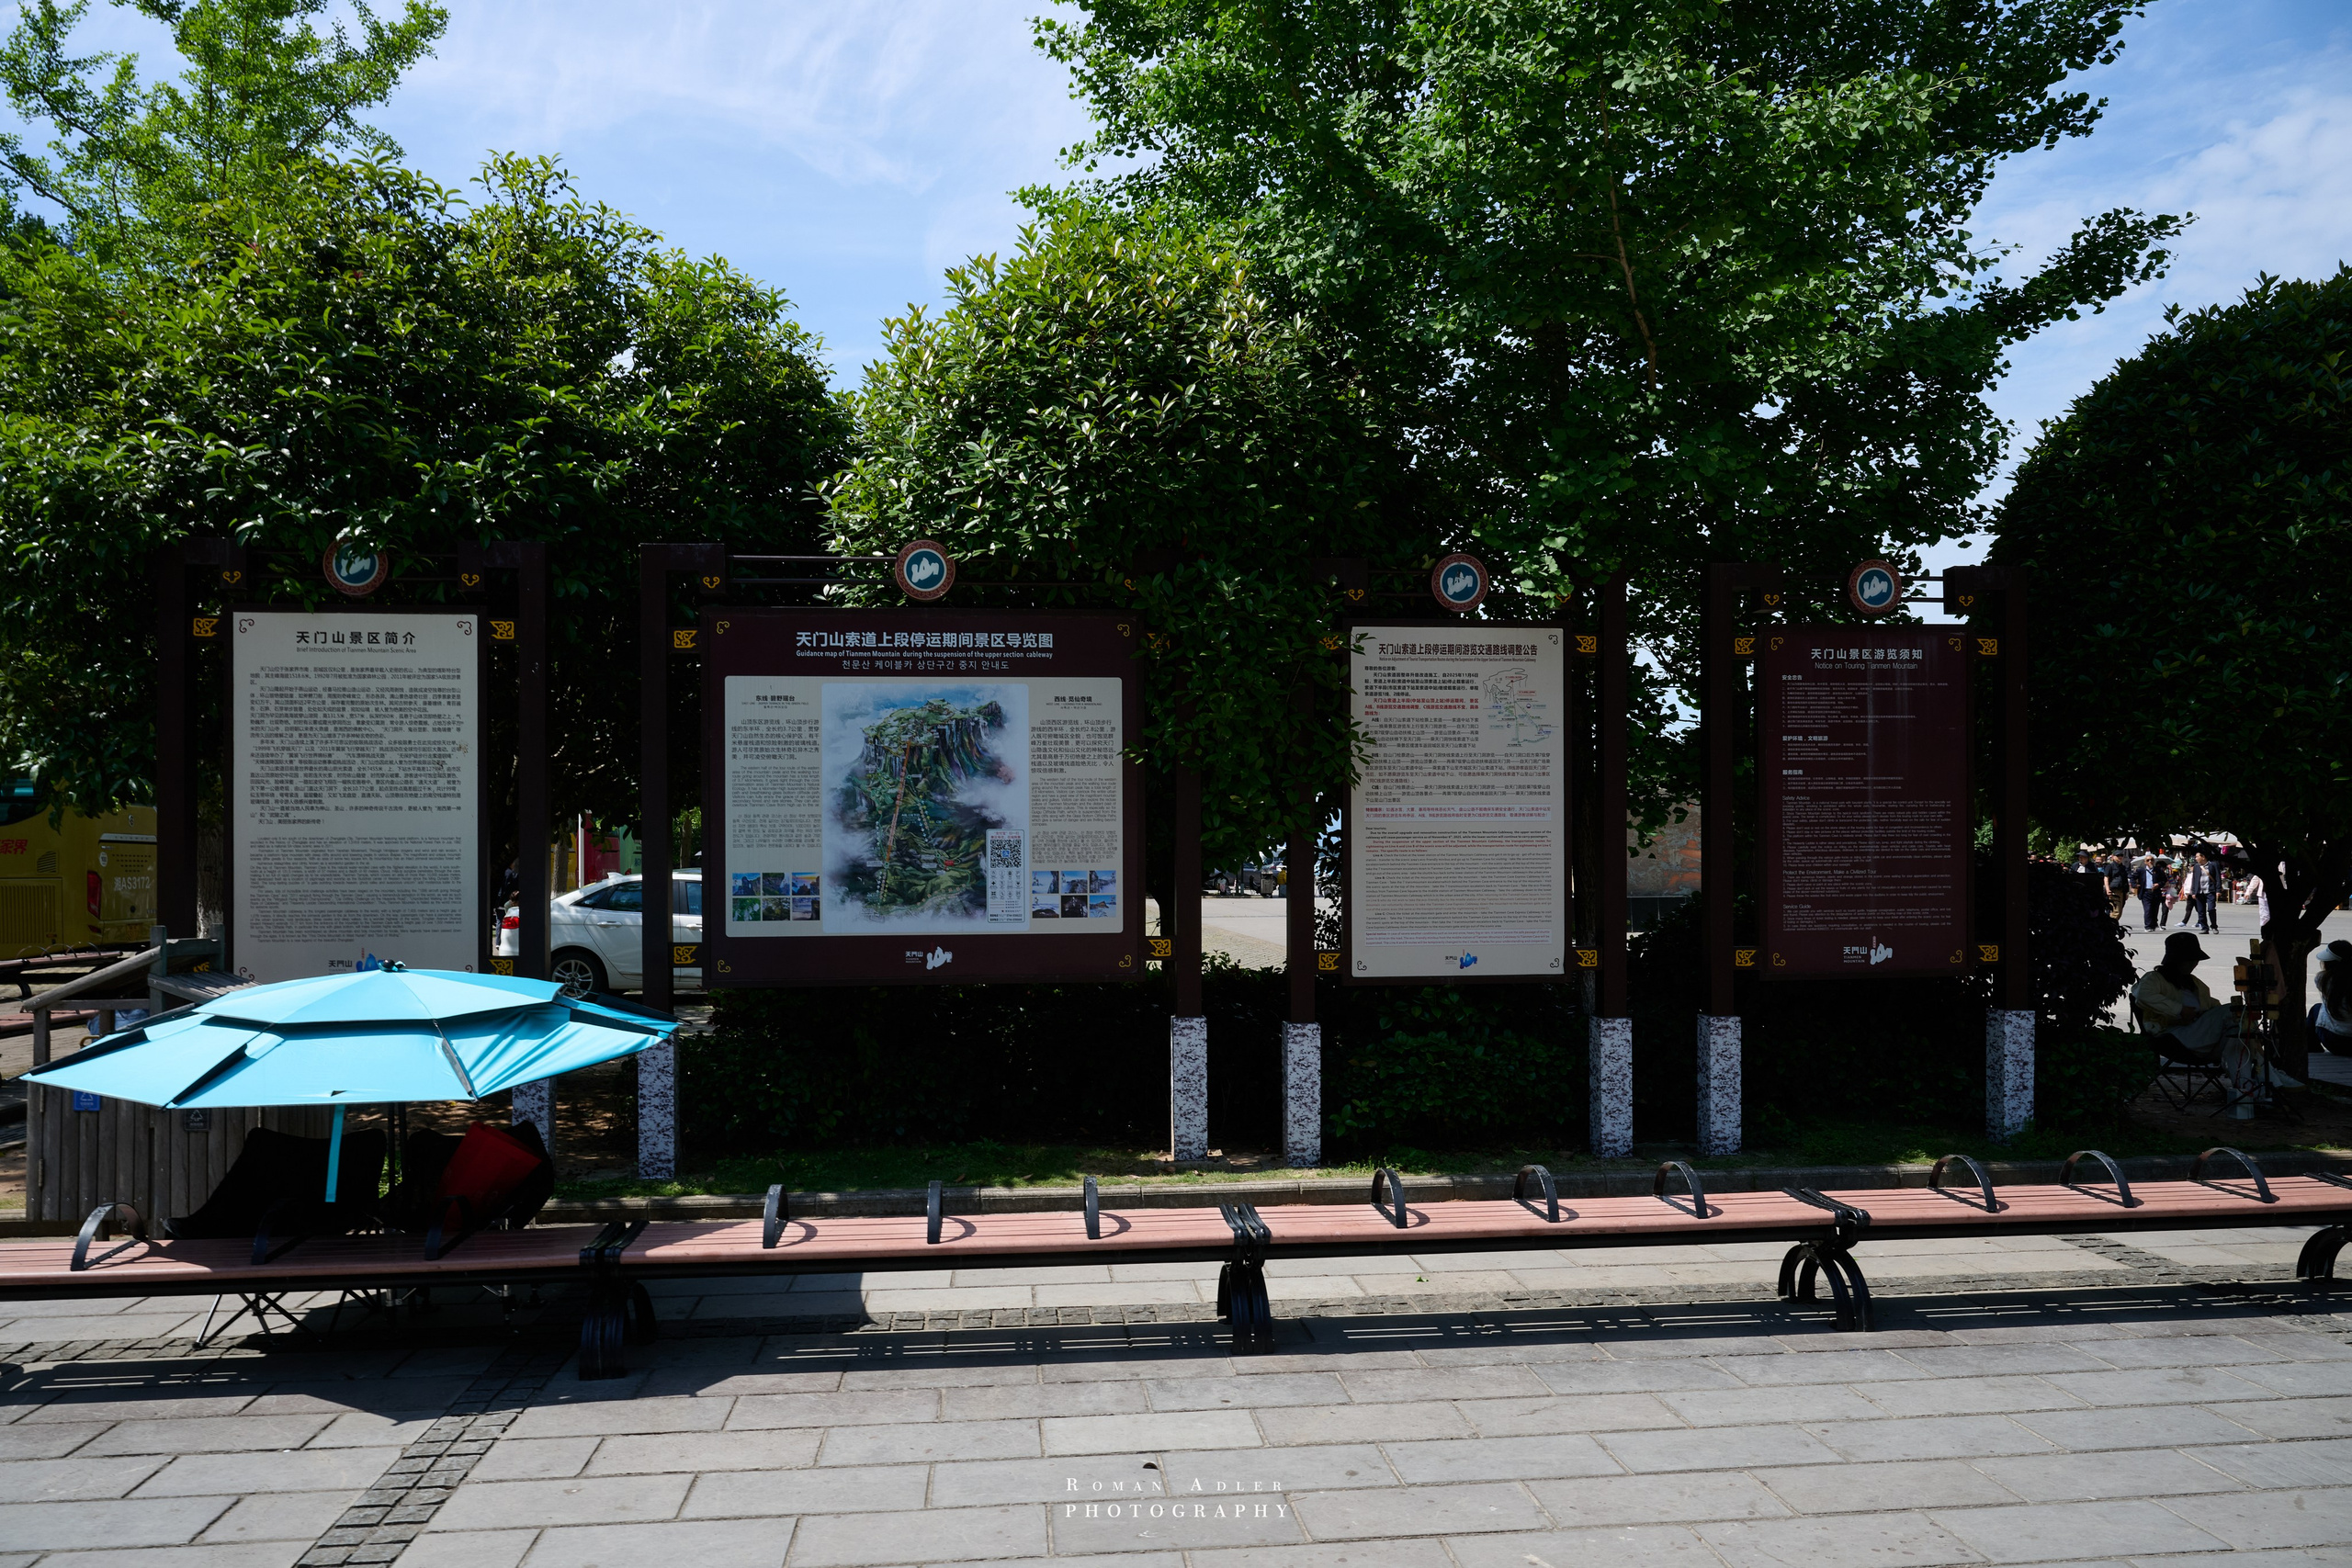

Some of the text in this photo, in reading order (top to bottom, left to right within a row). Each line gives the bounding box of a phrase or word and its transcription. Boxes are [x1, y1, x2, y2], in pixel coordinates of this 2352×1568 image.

[296, 631, 416, 645] 天门山景区简介
[796, 631, 1054, 649] 天门山索道上段停运期间景区导览图
[796, 649, 1053, 659] Guidance map of Tianmen Mountain during the suspension of the upper section cableway
[1379, 643, 1538, 655] 天门山索道上段停运期间游览交通路线调整公告
[1811, 648, 1923, 660] 天门山景区游览须知
[842, 660, 870, 670] 천문산
[917, 660, 955, 670] 상단구간
[959, 660, 977, 670] 중지
[981, 660, 1009, 670] 안내도
[1815, 661, 1918, 671] Notice on Touring Tianmen Mountain
[0, 839, 28, 854] 家界
[1843, 946, 1868, 954] 天門山
